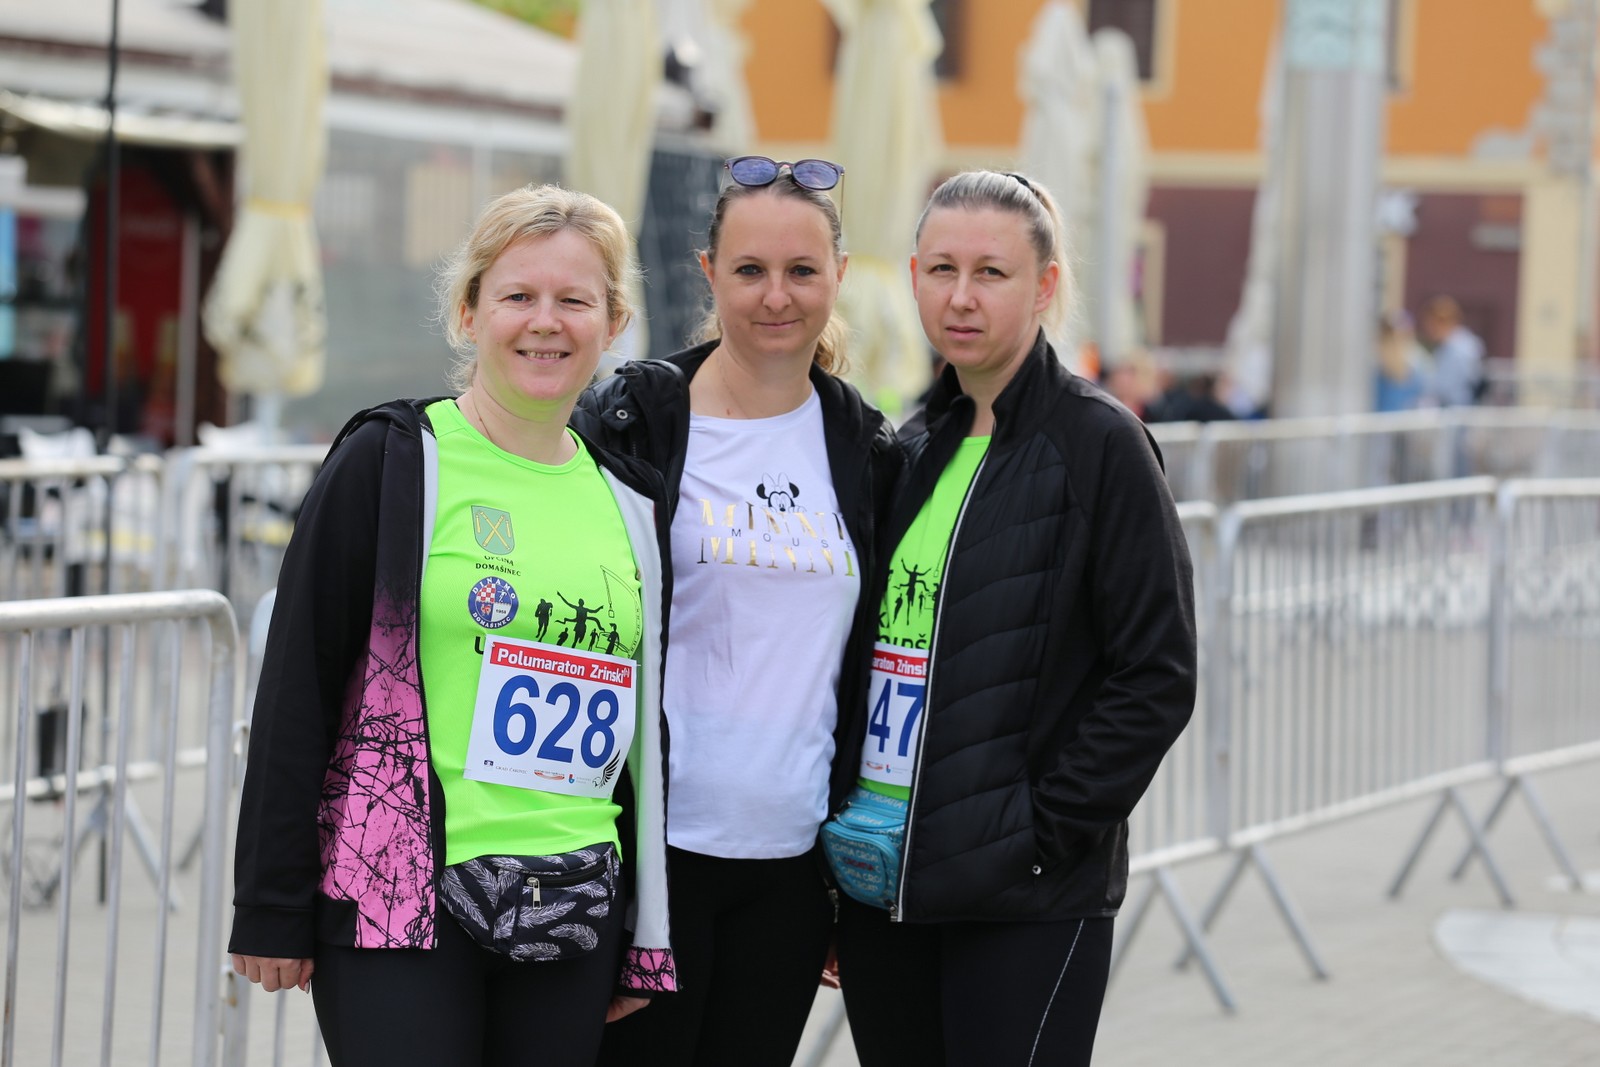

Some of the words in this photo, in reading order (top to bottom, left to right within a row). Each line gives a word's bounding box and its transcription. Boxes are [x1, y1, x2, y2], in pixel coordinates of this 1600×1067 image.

[731, 528, 853, 552] MOUSE
[475, 562, 522, 576] DOMAŠINEC
[472, 577, 516, 600] DINAMO
[497, 647, 585, 676] Polumaraton
[872, 656, 895, 671] araton
[493, 674, 619, 769] 628
[867, 677, 926, 757] 47
